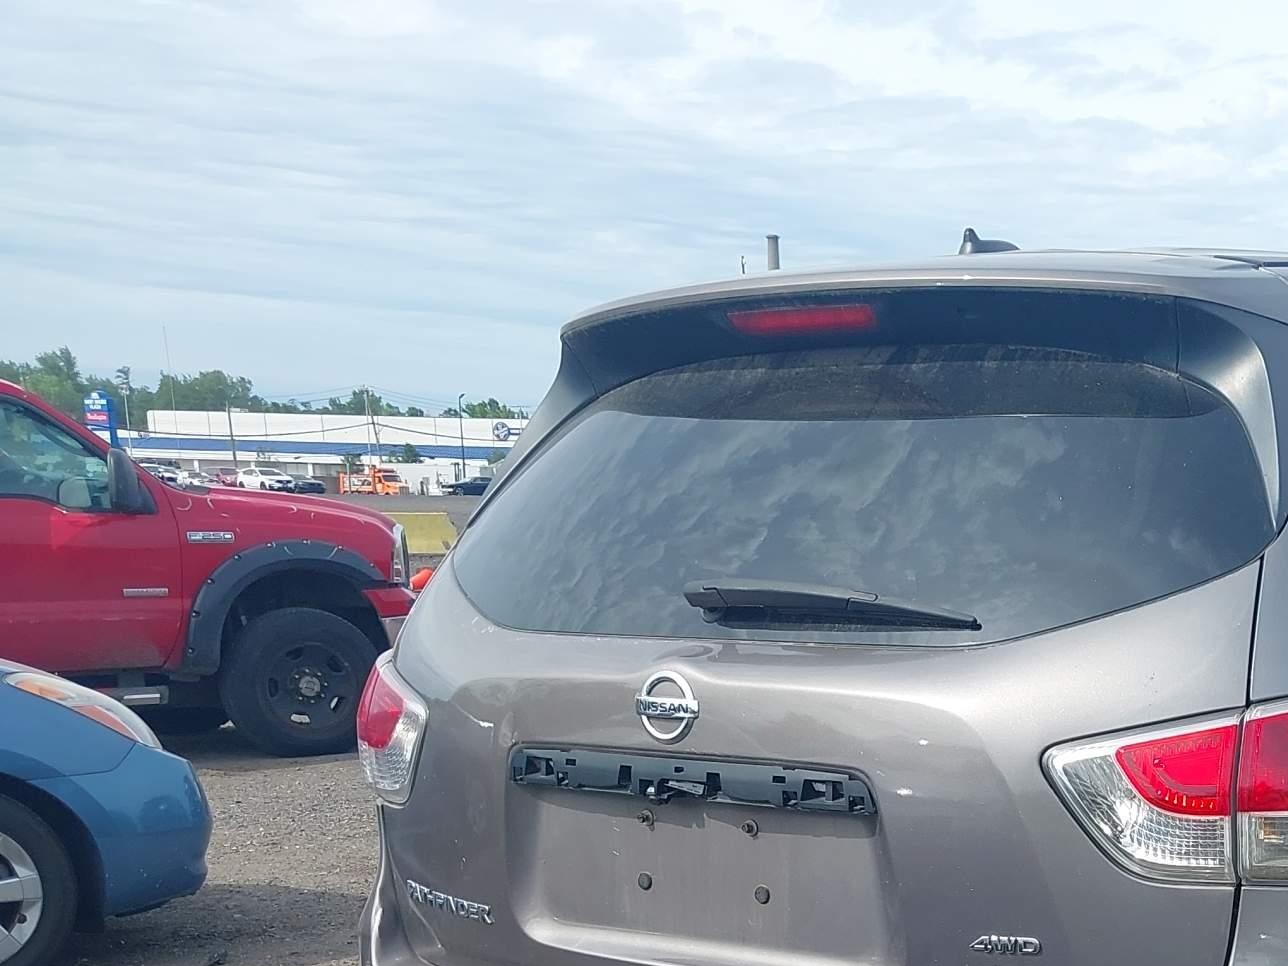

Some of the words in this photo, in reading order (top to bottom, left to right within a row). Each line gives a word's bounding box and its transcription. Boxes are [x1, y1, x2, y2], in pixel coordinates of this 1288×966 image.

[640, 700, 689, 714] NISSAN
[406, 879, 494, 925] PATHFINDER
[969, 934, 1041, 954] 4WD
